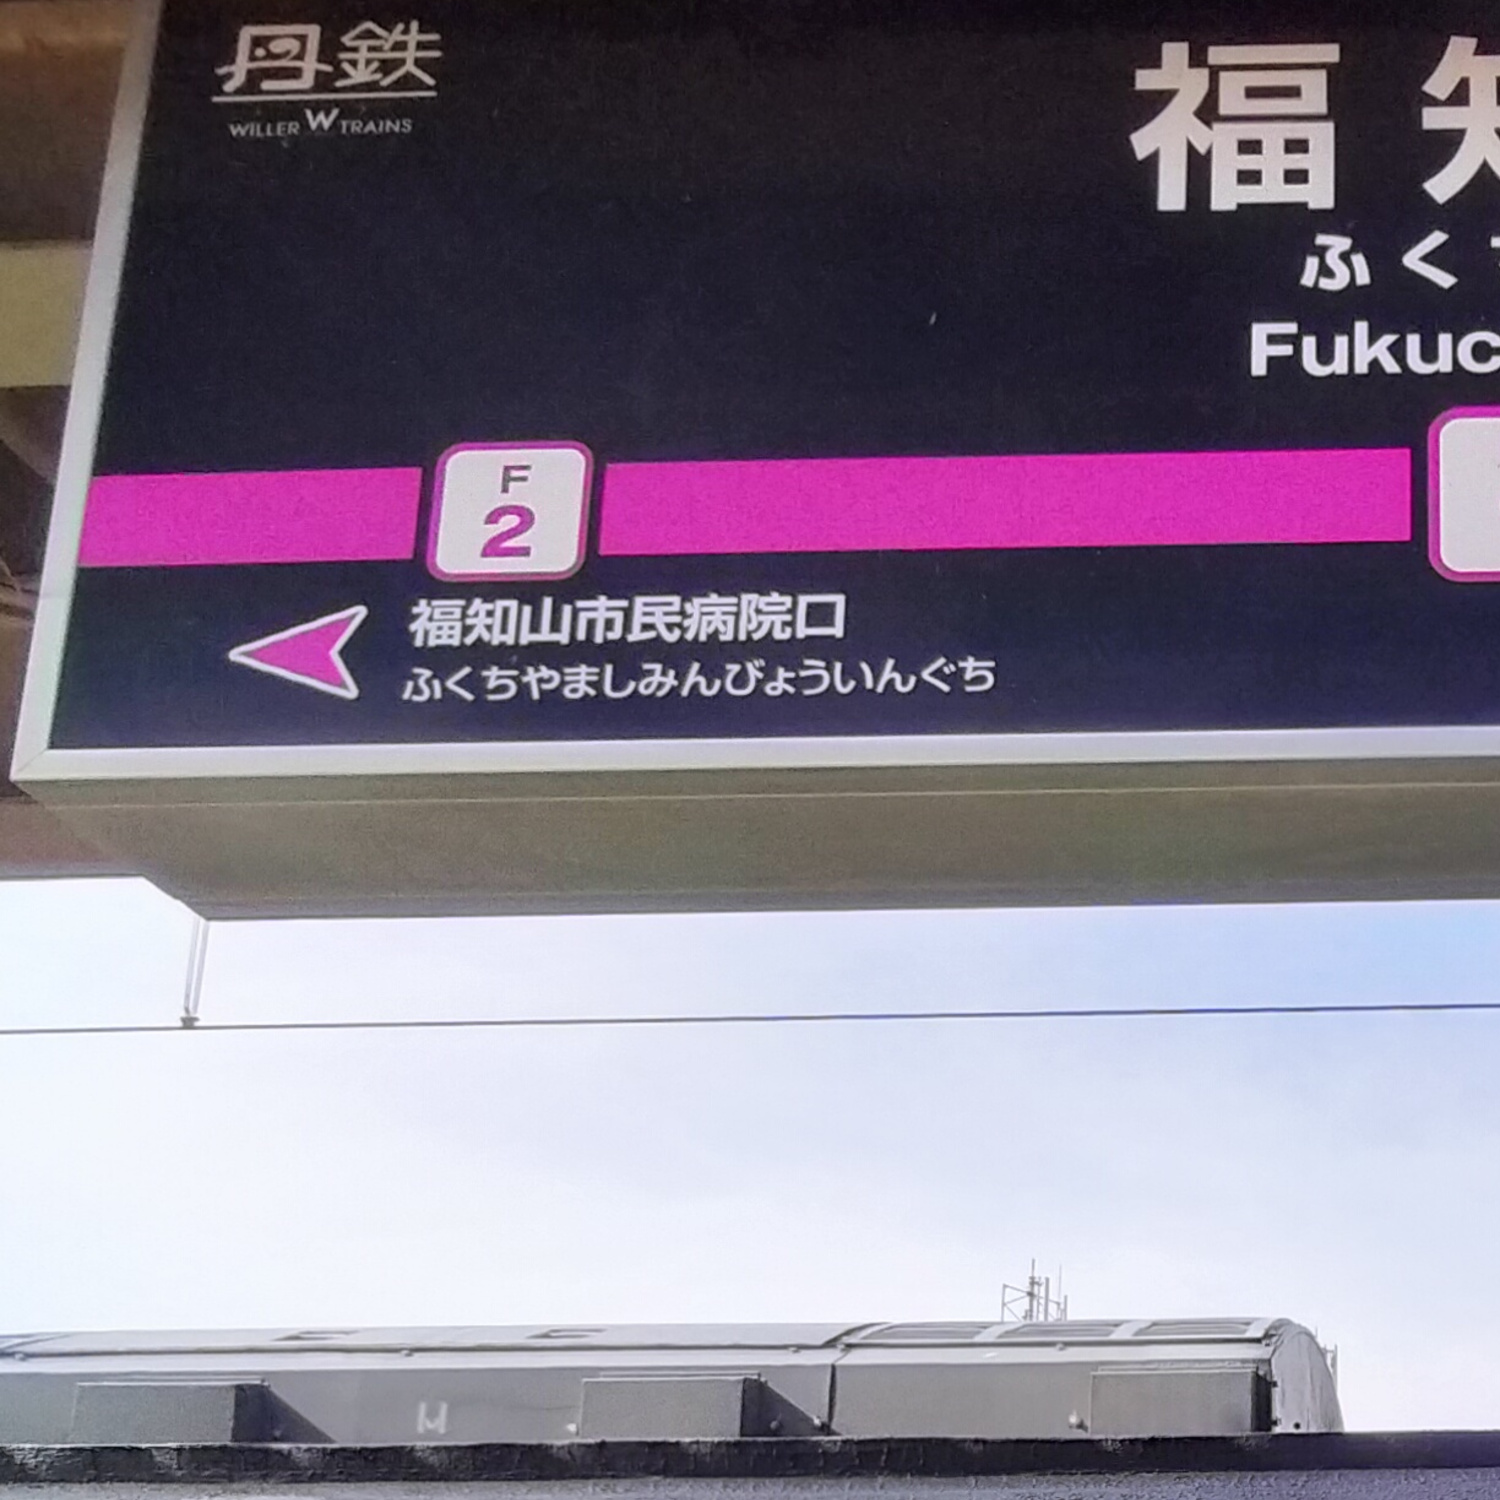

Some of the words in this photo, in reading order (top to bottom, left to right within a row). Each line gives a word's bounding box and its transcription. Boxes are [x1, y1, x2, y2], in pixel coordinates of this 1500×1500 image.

[214, 20, 442, 93] 丹鉄
[228, 121, 300, 138] WILLER
[341, 118, 413, 135] TRAINS
[500, 464, 532, 494] F
[480, 504, 535, 558] 2
[408, 592, 847, 648] 福知山市民病院口
[401, 655, 998, 703] ふくちやましみんびょういんぐち
